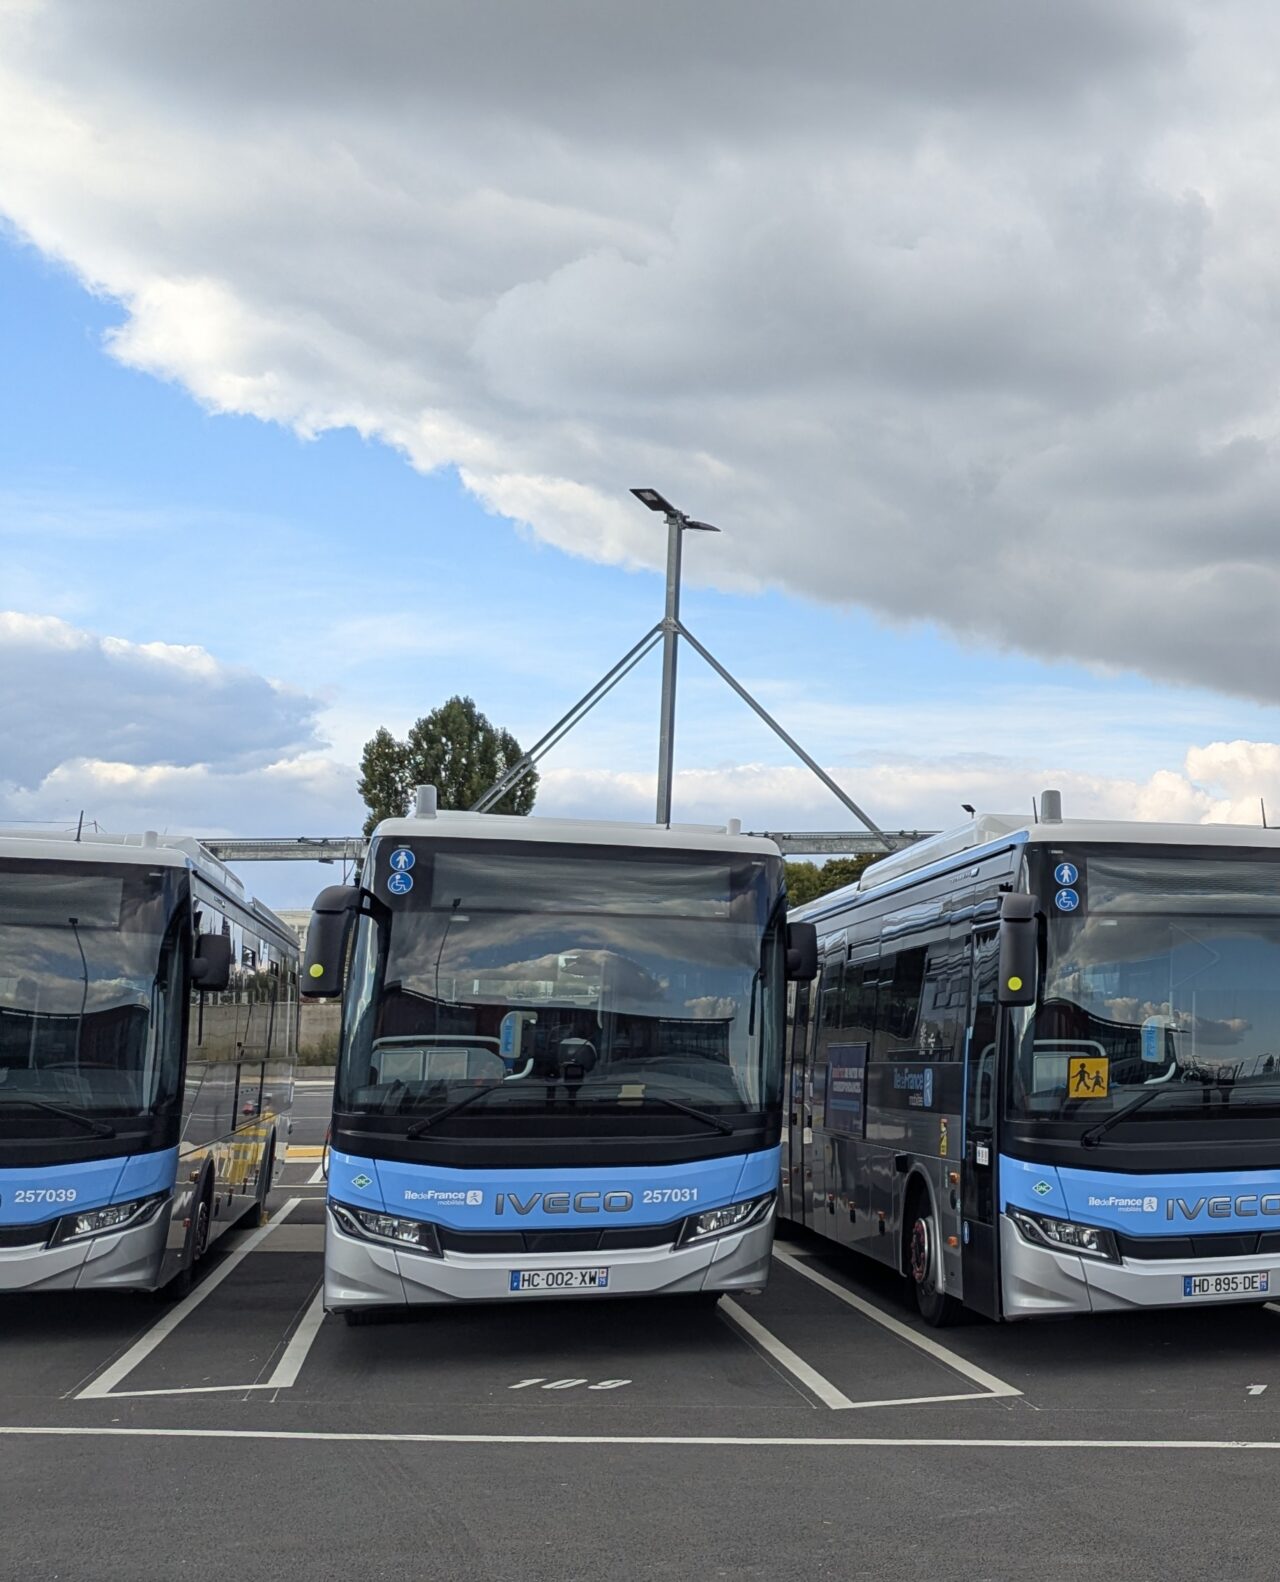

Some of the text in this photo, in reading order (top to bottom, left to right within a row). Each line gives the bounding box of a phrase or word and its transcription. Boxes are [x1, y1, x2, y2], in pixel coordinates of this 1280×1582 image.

[14, 1188, 77, 1203] 257039
[495, 1190, 634, 1216] IVECO
[642, 1188, 698, 1204] 257031
[521, 1270, 598, 1288] HC-002-XW
[1193, 1275, 1259, 1293] HD-895-DE
[507, 1378, 633, 1390] 109
